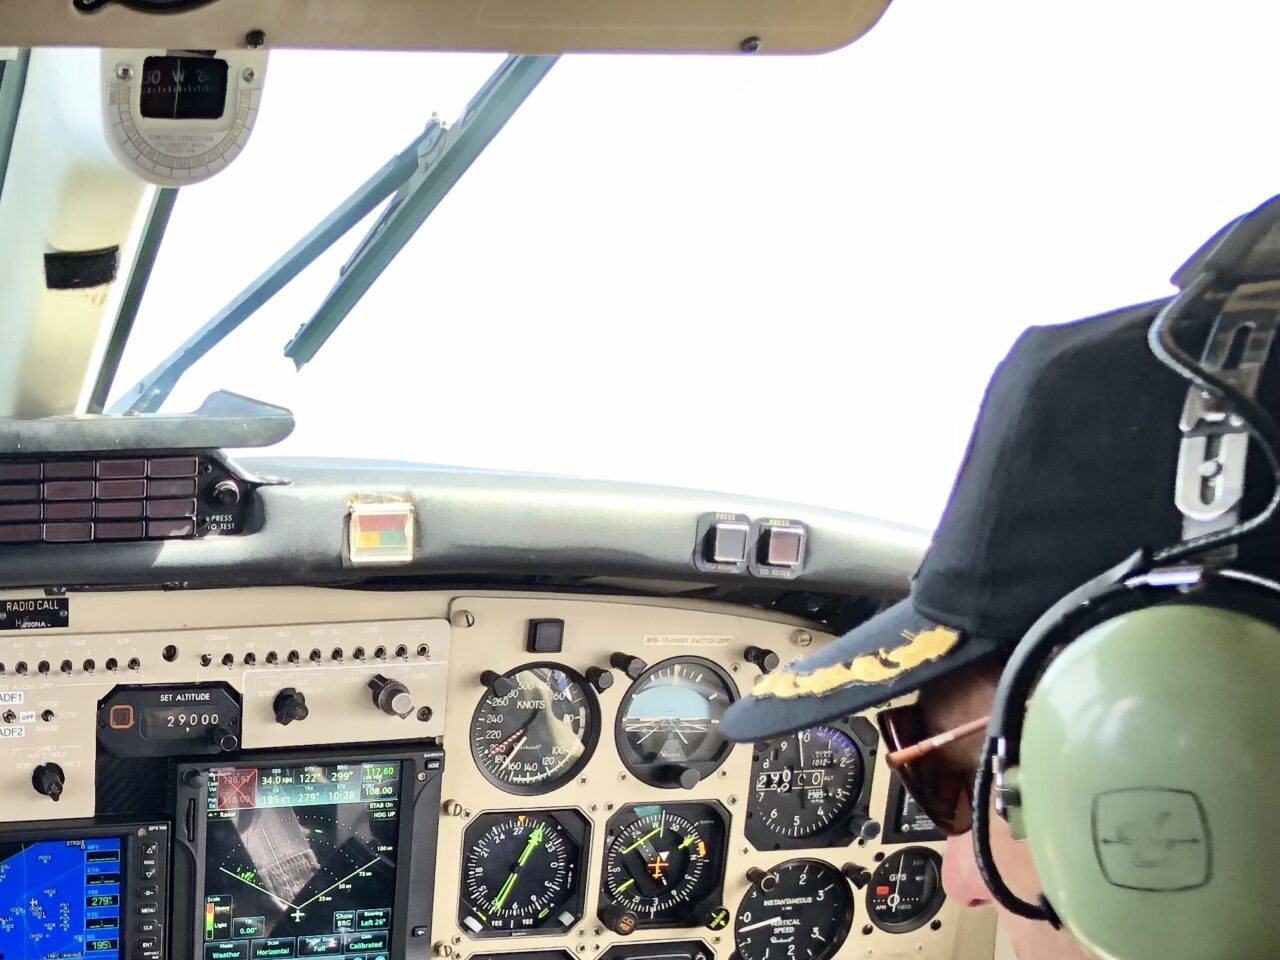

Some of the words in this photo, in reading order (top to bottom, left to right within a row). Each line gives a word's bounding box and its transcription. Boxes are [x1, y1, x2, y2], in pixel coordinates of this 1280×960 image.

[6, 601, 35, 612] RADIO
[36, 600, 59, 610] CALL
[175, 693, 210, 701] ALTITUDE
[492, 698, 509, 707] 260
[516, 700, 545, 710] KNOTS
[167, 713, 219, 727] 29000
[486, 715, 504, 724] 240
[485, 730, 502, 739] 220
[365, 767, 394, 776] 117.60
[523, 762, 538, 772] 140
[261, 775, 281, 785] 34.0
[327, 790, 355, 801] 10:28
[364, 786, 393, 796] 108.00
[763, 897, 812, 906] INSTANTANEOUS
[336, 912, 353, 920] Show
[337, 919, 352, 927] BRG
[773, 926, 795, 934] SPEED
[313, 944, 326, 952] Full
[349, 940, 383, 949] Calibrated
[212, 950, 241, 959] Weather
[256, 947, 290, 956] Horizontal
